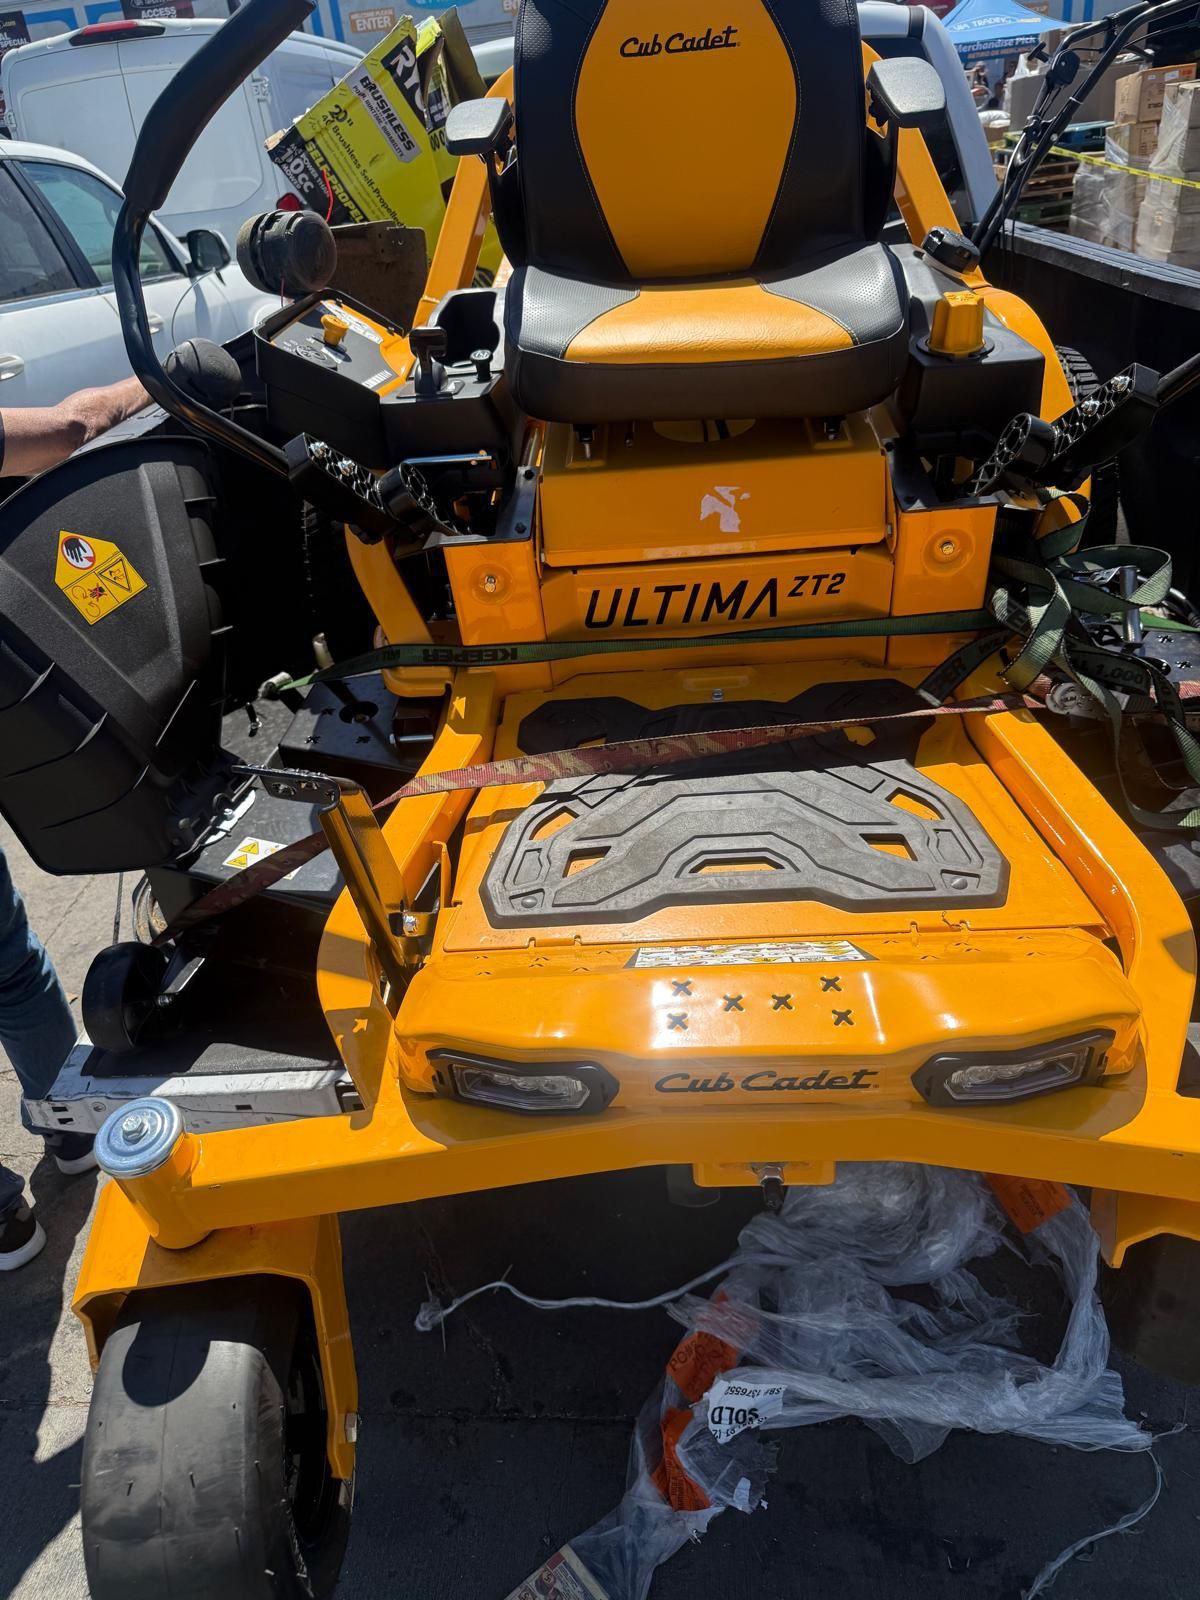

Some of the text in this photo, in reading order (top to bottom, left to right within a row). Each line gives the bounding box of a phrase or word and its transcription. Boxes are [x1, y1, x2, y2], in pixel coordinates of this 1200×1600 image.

[141, 6, 177, 19] ACCESS
[356, 16, 392, 32] ENTER
[619, 25, 738, 58] Cub Cadet
[359, 75, 416, 152] BRUSHLESS
[331, 125, 362, 170] Brushless
[584, 572, 847, 629] ULTIMA ZT2
[423, 647, 518, 663] KEEPER
[654, 1068, 880, 1093] Cub Cadet
[710, 1406, 759, 1425] SOLD
